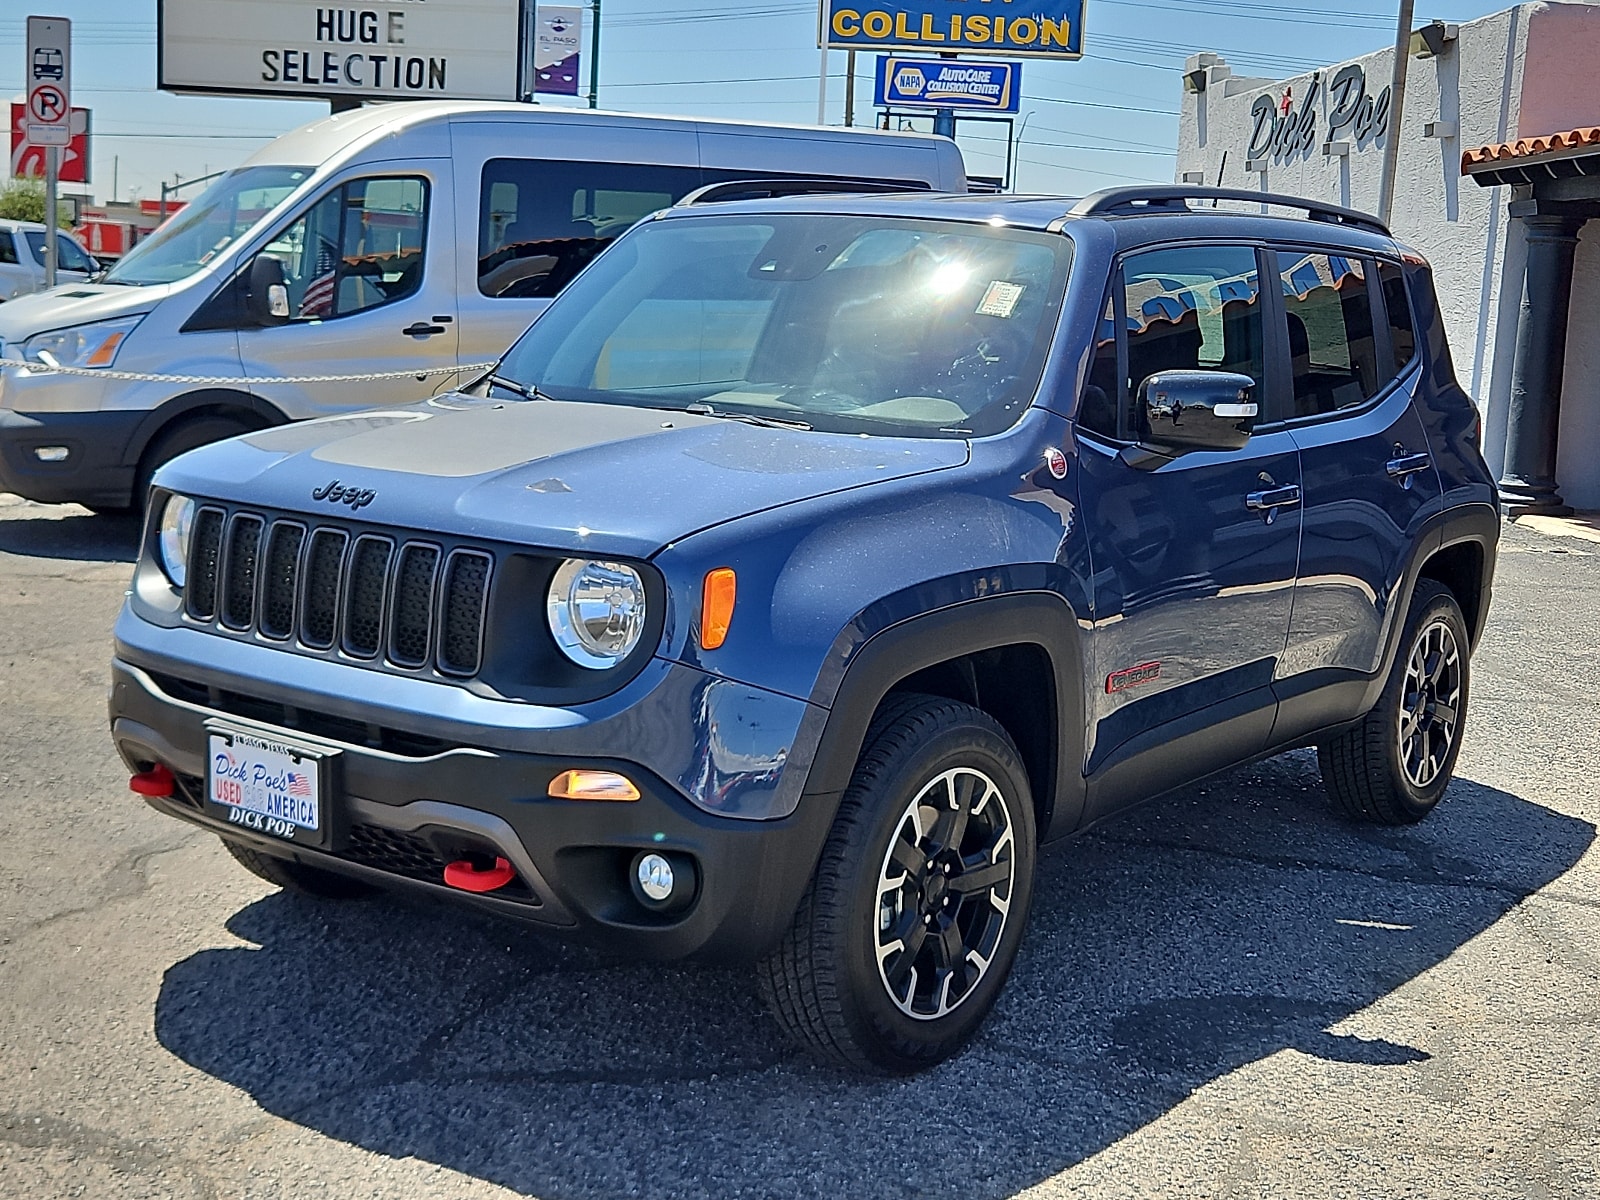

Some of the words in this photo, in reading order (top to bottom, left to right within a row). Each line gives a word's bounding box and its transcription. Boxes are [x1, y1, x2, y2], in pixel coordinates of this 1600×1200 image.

[316, 8, 405, 44] HUGE
[553, 36, 578, 44] PASO
[831, 9, 1071, 47] COLLISION
[261, 50, 447, 90] SELECTION
[899, 74, 921, 89] NAPA
[926, 80, 968, 93] COLLISION
[968, 83, 1001, 95] CENTER
[1247, 81, 1317, 160] Dick
[1325, 63, 1391, 143] Poe
[312, 479, 378, 511] Jeep
[215, 753, 248, 782] Dick
[253, 764, 288, 792] Poe's
[216, 778, 242, 804] USED
[267, 792, 315, 825] AMERICA
[229, 806, 264, 830] DICK
[265, 818, 296, 838] POE
